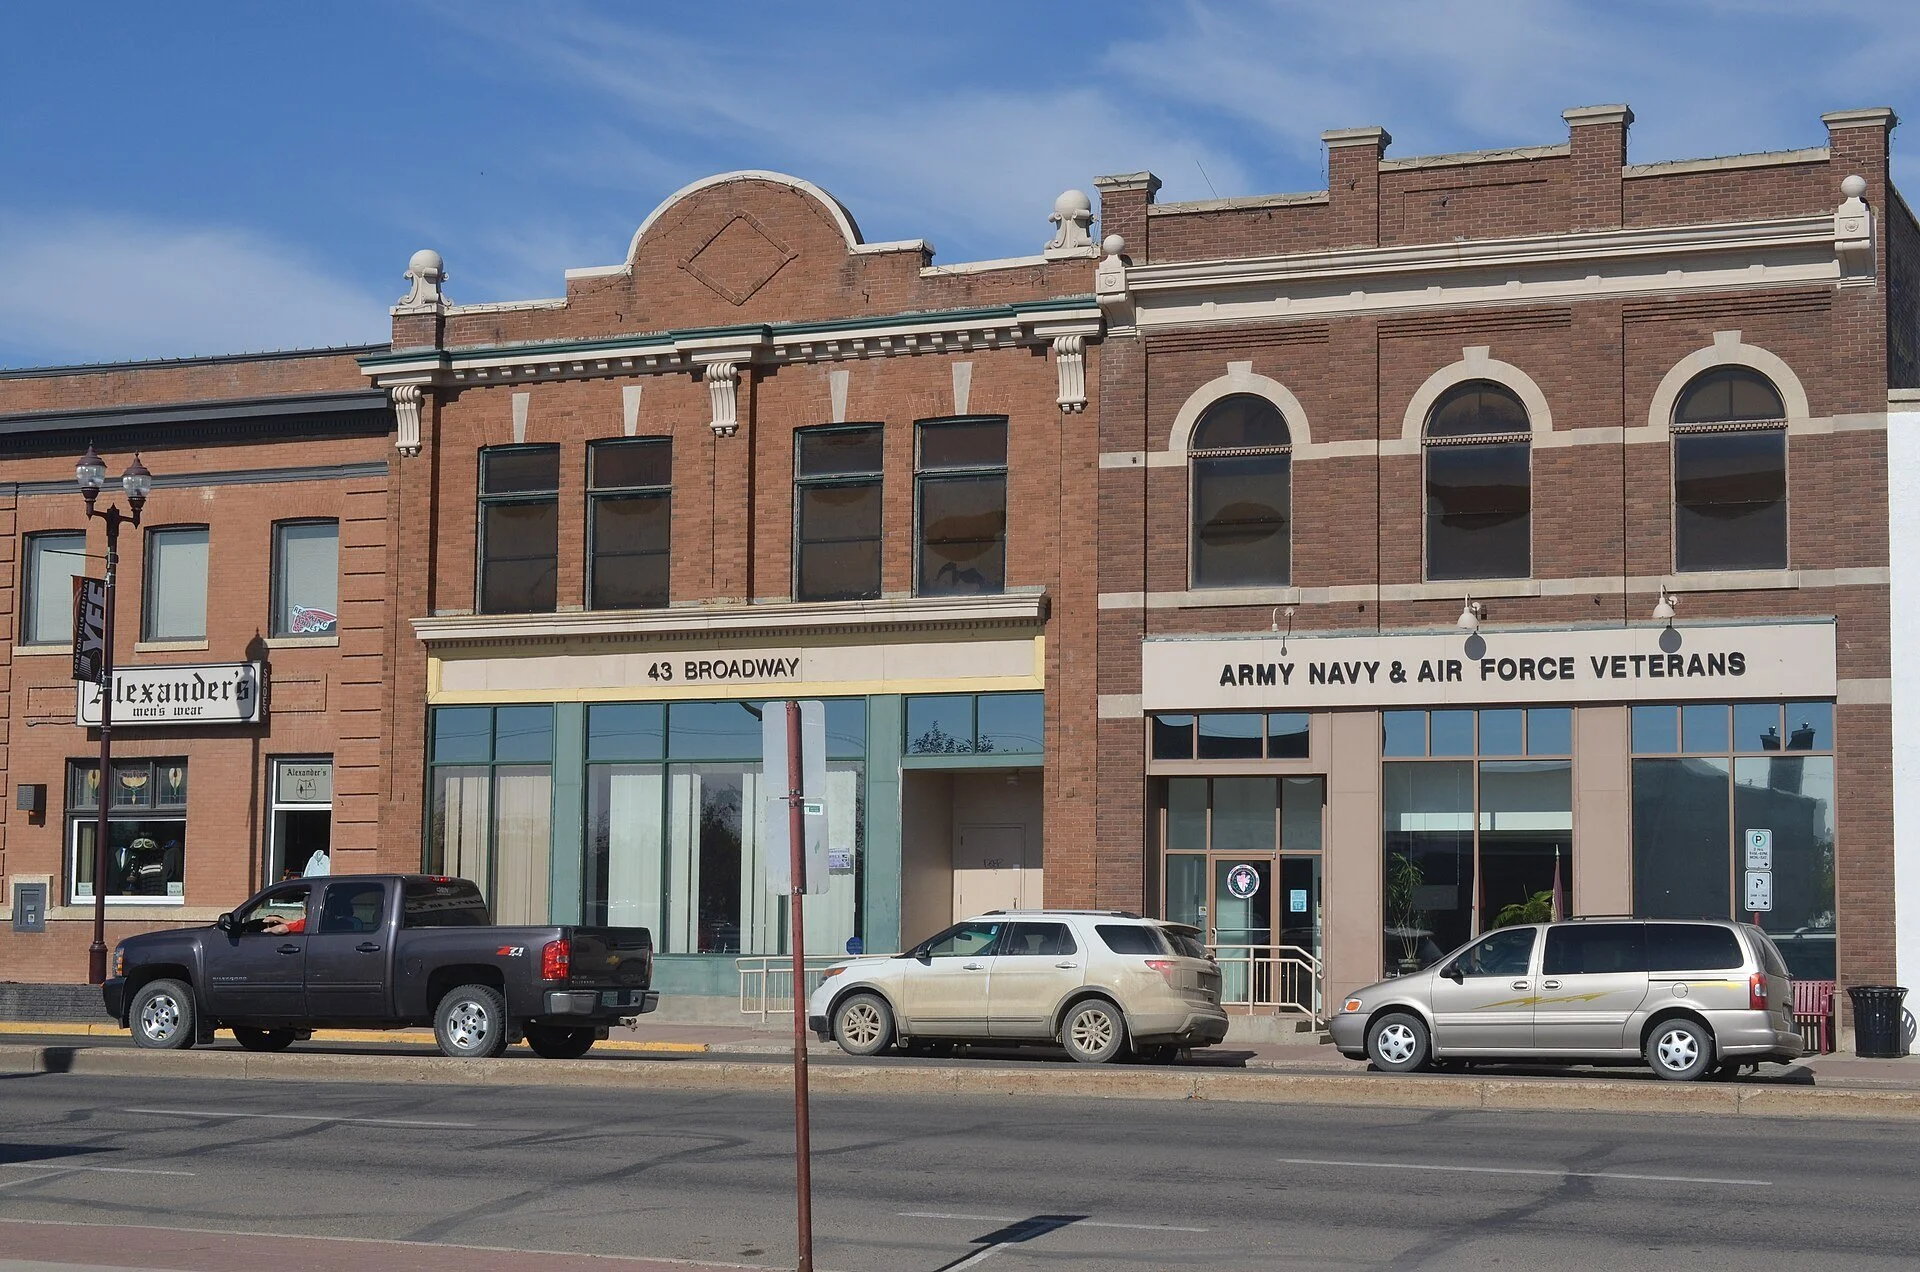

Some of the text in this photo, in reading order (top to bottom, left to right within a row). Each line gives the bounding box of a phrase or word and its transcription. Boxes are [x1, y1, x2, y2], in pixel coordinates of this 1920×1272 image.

[648, 657, 800, 681] 43 BROADWAY
[1219, 651, 1746, 686] ARMY NAVY & AIR FORCE VETERANS
[132, 704, 204, 717] men's wear
[286, 768, 327, 777] Alexander's
